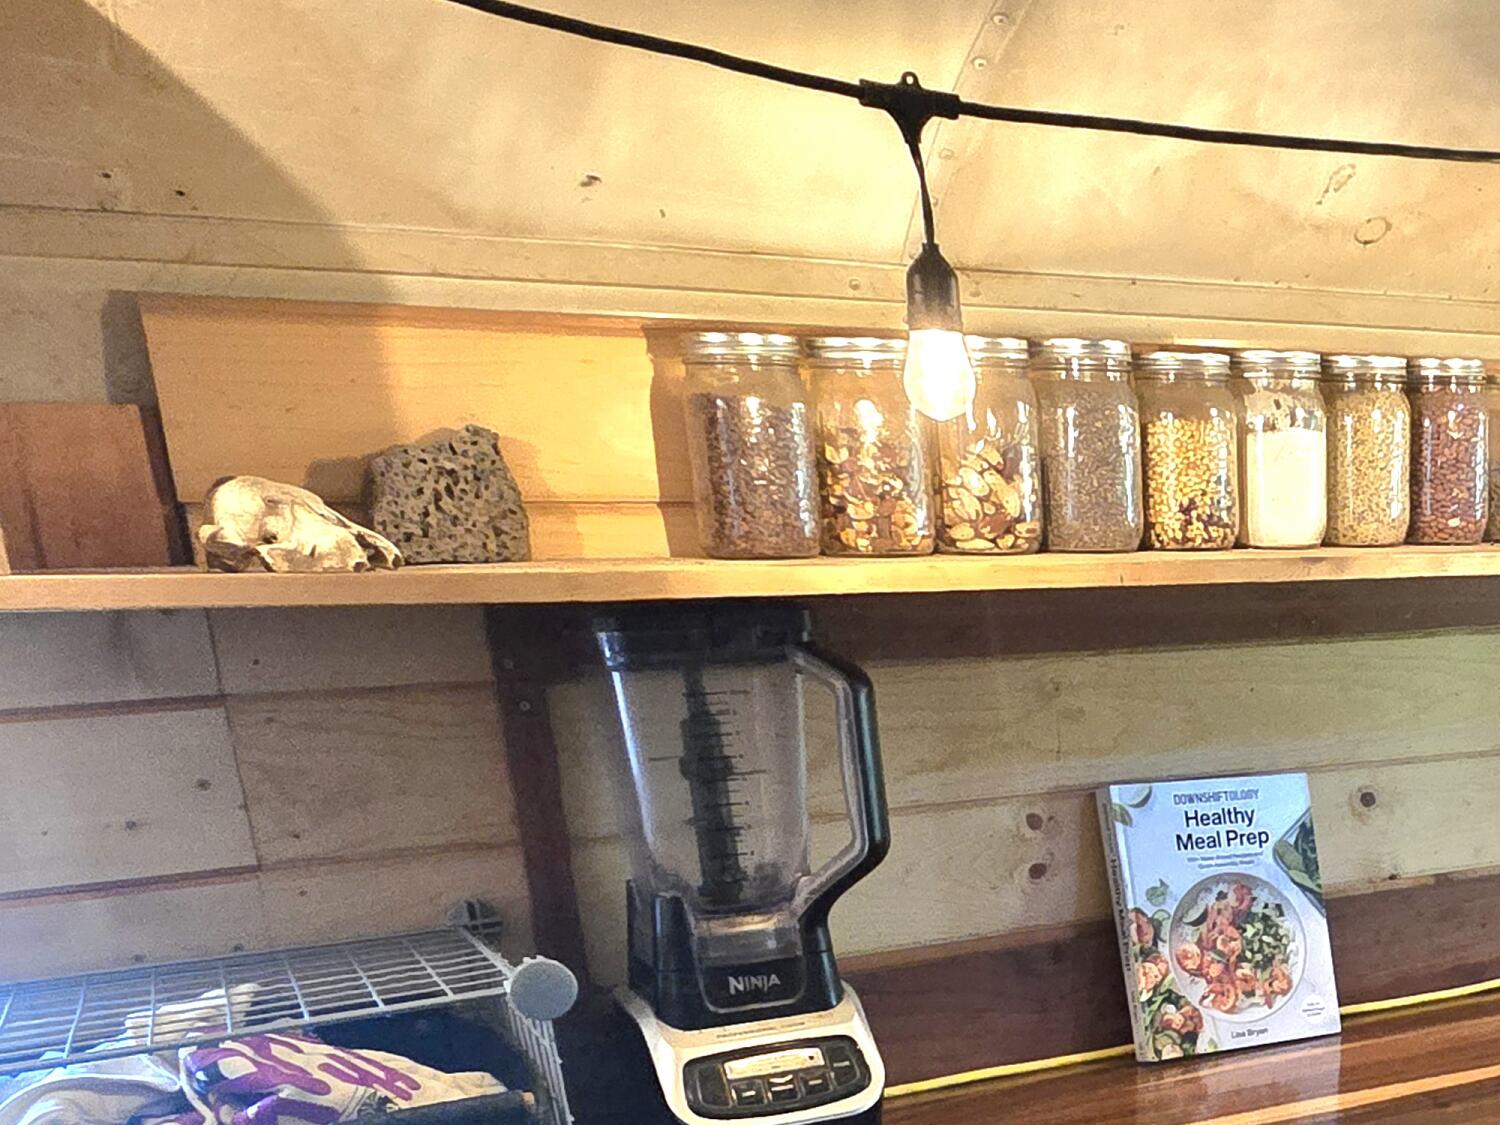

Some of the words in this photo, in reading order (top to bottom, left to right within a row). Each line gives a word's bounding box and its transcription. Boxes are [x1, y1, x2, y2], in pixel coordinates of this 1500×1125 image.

[1173, 789, 1259, 805] DOWNSHIFTOLOGY
[1185, 807, 1255, 827] Healthy
[1176, 831, 1222, 851] Meal
[1226, 830, 1269, 848] Prep
[728, 974, 781, 995] NINJA
